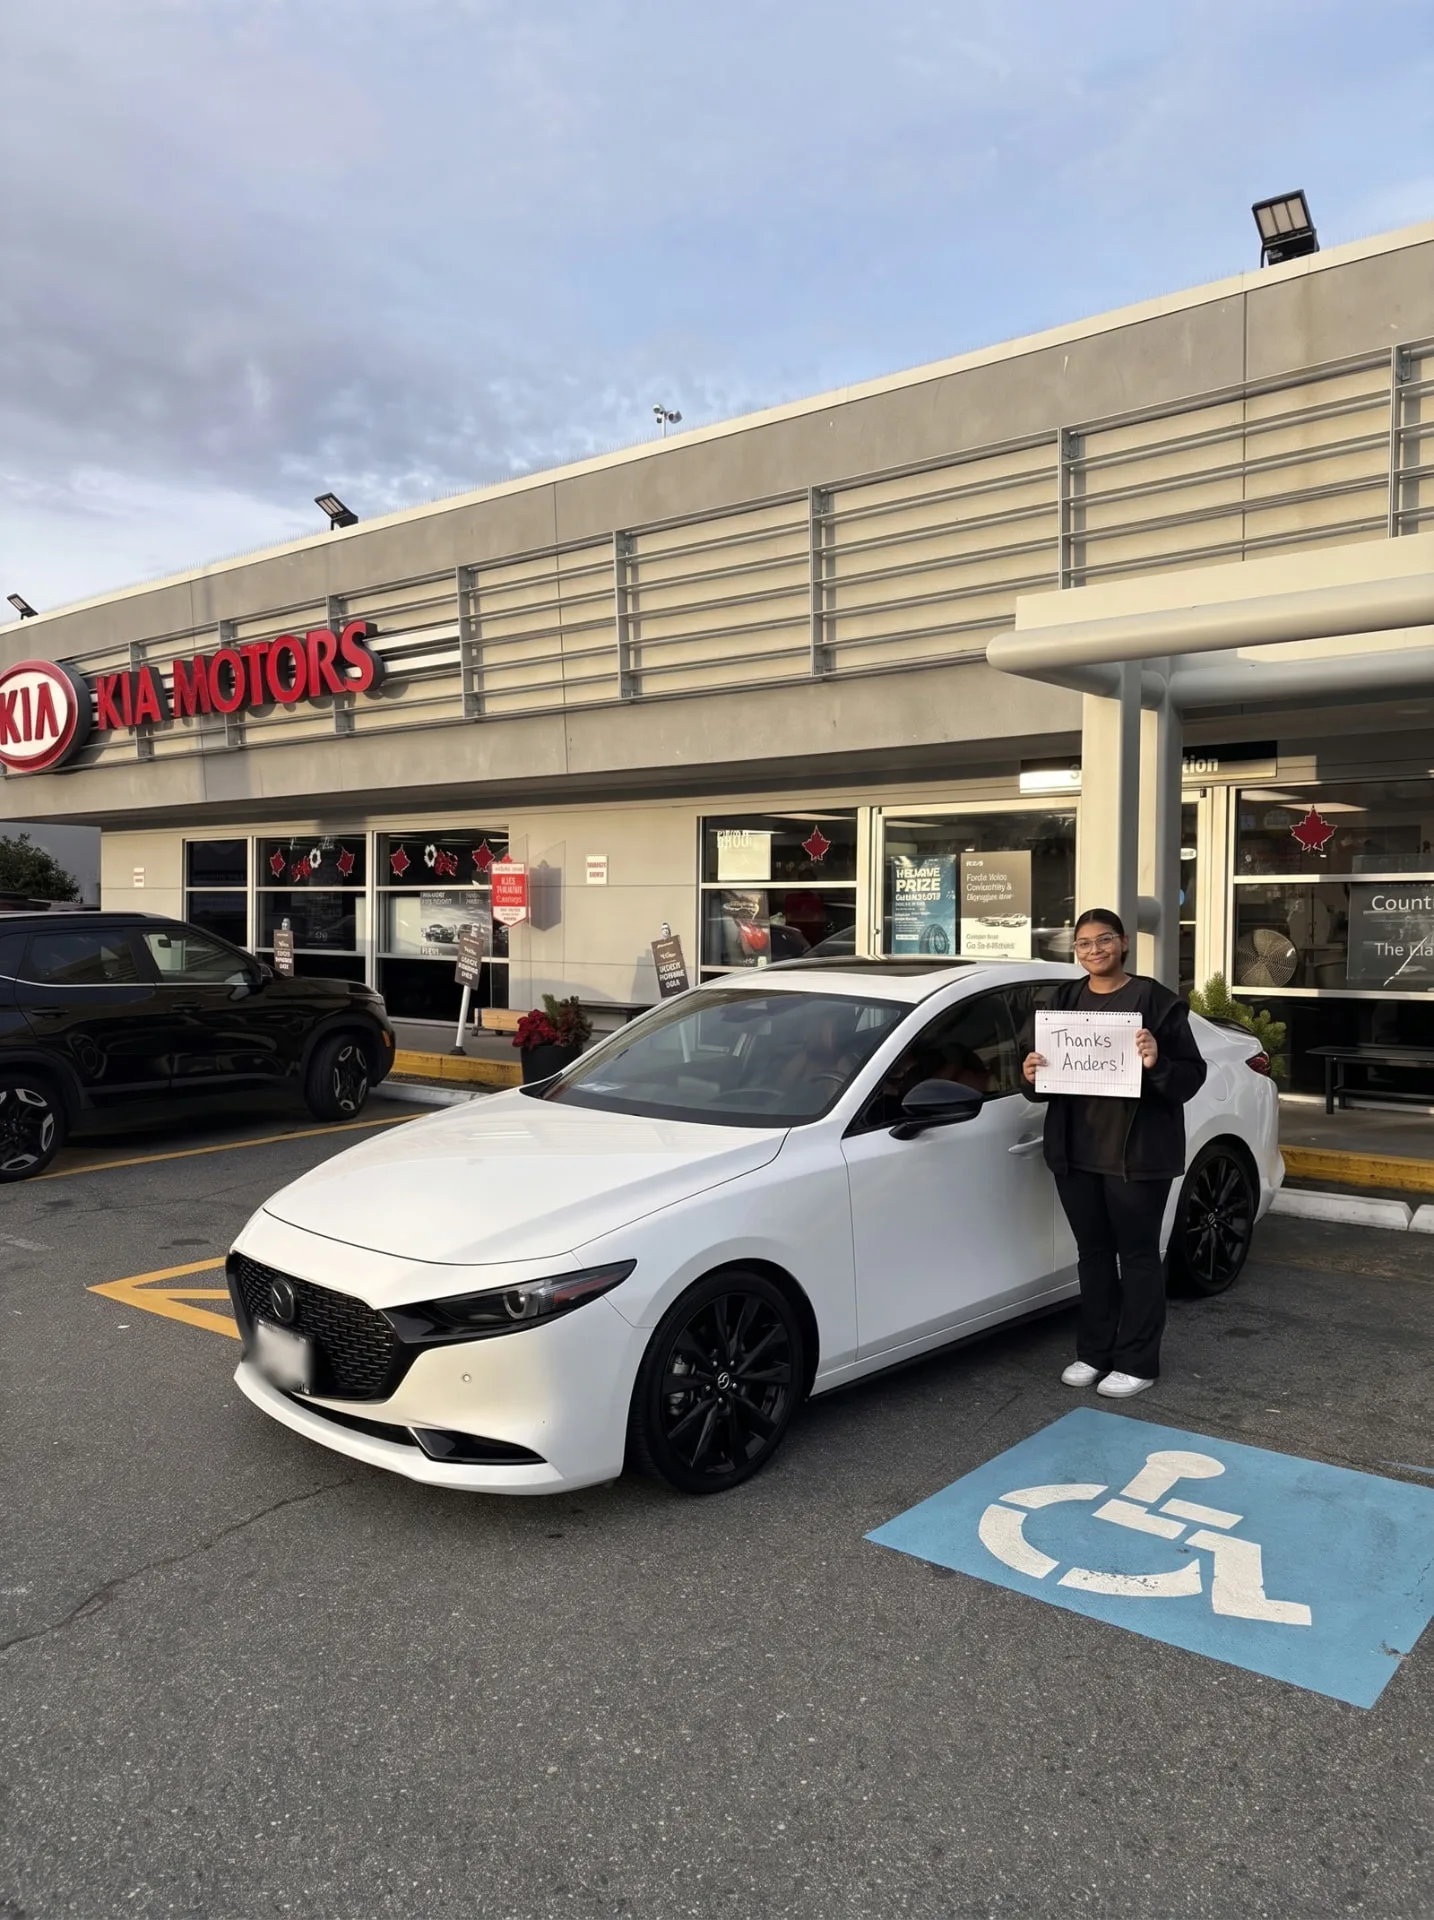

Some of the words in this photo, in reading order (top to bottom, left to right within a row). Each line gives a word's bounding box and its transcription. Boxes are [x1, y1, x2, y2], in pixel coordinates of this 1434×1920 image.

[96, 666, 163, 730] KIA
[172, 619, 375, 718] MOTORS
[0, 682, 60, 745] KIA
[1182, 756, 1219, 774] tion
[895, 878, 941, 892] PRIZE
[1371, 895, 1434, 911] Count
[1374, 942, 1404, 956] The
[1051, 1028, 1112, 1048] Thanks
[1062, 1051, 1124, 1072] Anders!
